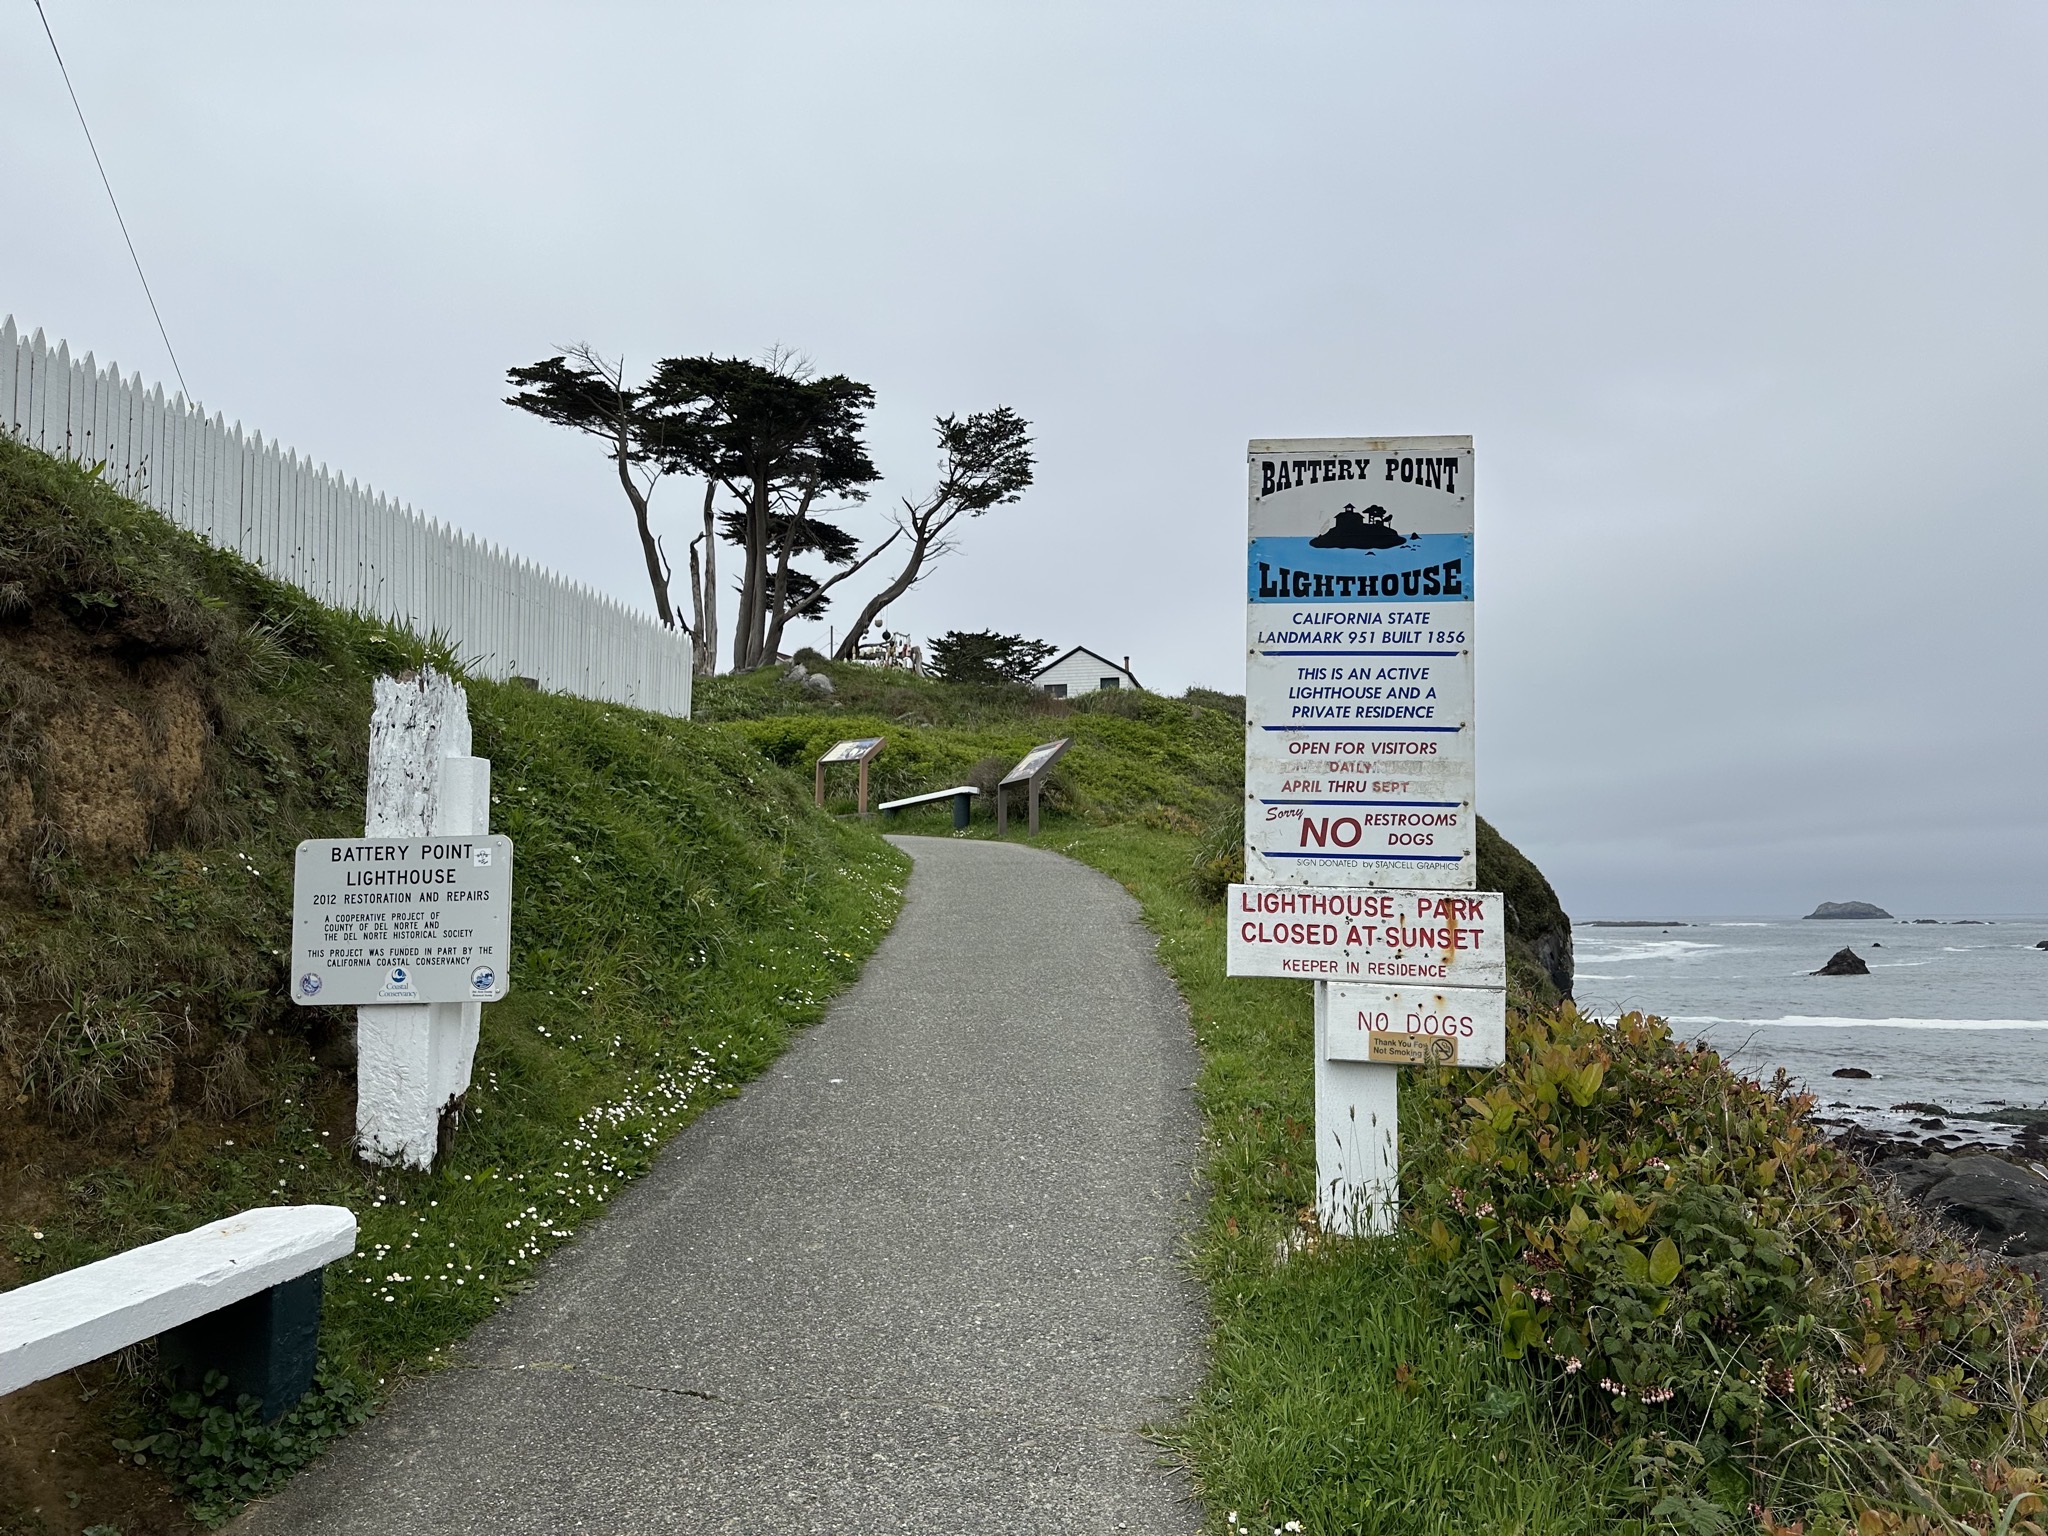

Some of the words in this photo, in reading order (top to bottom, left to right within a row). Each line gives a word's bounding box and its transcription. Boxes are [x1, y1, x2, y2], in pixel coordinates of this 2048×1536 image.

[1261, 459, 1370, 497] BATTERY
[1385, 457, 1458, 494] POINT
[1259, 558, 1462, 598] LIGHTHOUSE
[1292, 612, 1383, 625] CALIFORNIA
[1388, 612, 1430, 624] STATE
[1258, 631, 1343, 644] LANDMARK
[1348, 631, 1375, 644] 951
[1382, 631, 1422, 644] BUILT
[1428, 631, 1465, 644] 1856
[1297, 667, 1327, 680] THIS
[1331, 667, 1343, 680] IS
[1348, 667, 1371, 680] AN
[1376, 667, 1430, 680] ACTIVE
[1288, 687, 1382, 699] LIGHTHOUSE
[1386, 687, 1421, 699] AND
[1425, 687, 1437, 699] A
[1292, 706, 1352, 718] PRIVATE
[1355, 706, 1434, 718] RESIDENCE
[1289, 742, 1330, 755] OPEN
[1334, 742, 1365, 755] FOR
[1371, 742, 1437, 755] VISITORS
[1329, 761, 1371, 773] DAILY
[1281, 781, 1322, 793] APRIL
[1328, 781, 1367, 793] THRU
[1372, 781, 1410, 793] SEPT
[1265, 807, 1303, 821] Sorry
[1300, 817, 1362, 848] NO
[1364, 813, 1457, 827] RESTROOMS
[1388, 833, 1434, 846] DOGS
[331, 846, 409, 862] BATTERY
[421, 844, 473, 859] POINT
[1297, 859, 1317, 867] SIGN
[1319, 859, 1358, 868] DONATED
[1362, 860, 1374, 869] by
[1375, 860, 1414, 870] STANCELL
[1416, 861, 1459, 871] GRAPHICS
[347, 869, 457, 886] LIGHTHOUSE
[313, 894, 337, 905] 2012
[344, 893, 412, 904] RESTORATION
[419, 892, 439, 902] AND
[447, 891, 490, 902] REPAIRS
[1242, 893, 1395, 918] LIGHTHOUSE
[1417, 897, 1484, 921] PARK
[325, 914, 330, 922] A
[336, 913, 386, 922] COOPERATIVE
[391, 912, 424, 921] PROJECT
[431, 912, 441, 920] OF
[324, 923, 354, 932] COUNTY
[359, 922, 369, 931] OF
[374, 922, 388, 931] DEL
[394, 921, 419, 930] NORTE
[424, 921, 440, 929] AND
[324, 933, 338, 941] THE
[344, 932, 358, 941] DEL
[363, 931, 388, 940] NORTE
[393, 930, 437, 939] HISTORICAL
[443, 929, 473, 938] SOCIETY
[1241, 923, 1338, 945] CLOSED
[1346, 926, 1377, 946] AT
[1386, 927, 1484, 950] SUNSET
[308, 949, 325, 958] THIS
[330, 949, 363, 958] PROJECT
[369, 948, 385, 957] WAS
[390, 948, 419, 957] FUNDED
[424, 947, 432, 956] IN
[437, 947, 457, 955] PART
[462, 947, 473, 955] BY
[479, 946, 493, 955] THE
[327, 958, 371, 967] CALIFORNIA
[376, 957, 410, 966] COASTAL
[416, 957, 470, 966] CONSERVANCY
[1283, 959, 1338, 973] KEEPER
[1346, 961, 1359, 974] IN
[1368, 962, 1447, 978] RESIDENCE
[386, 982, 409, 990] Coastal
[378, 990, 418, 998] Conservancy
[1358, 1011, 1389, 1032] NO
[1407, 1013, 1474, 1037] DOGS
[1374, 1038, 1396, 1047] Thank
[1398, 1040, 1411, 1048] You
[1389, 1048, 1422, 1058] Smoking
